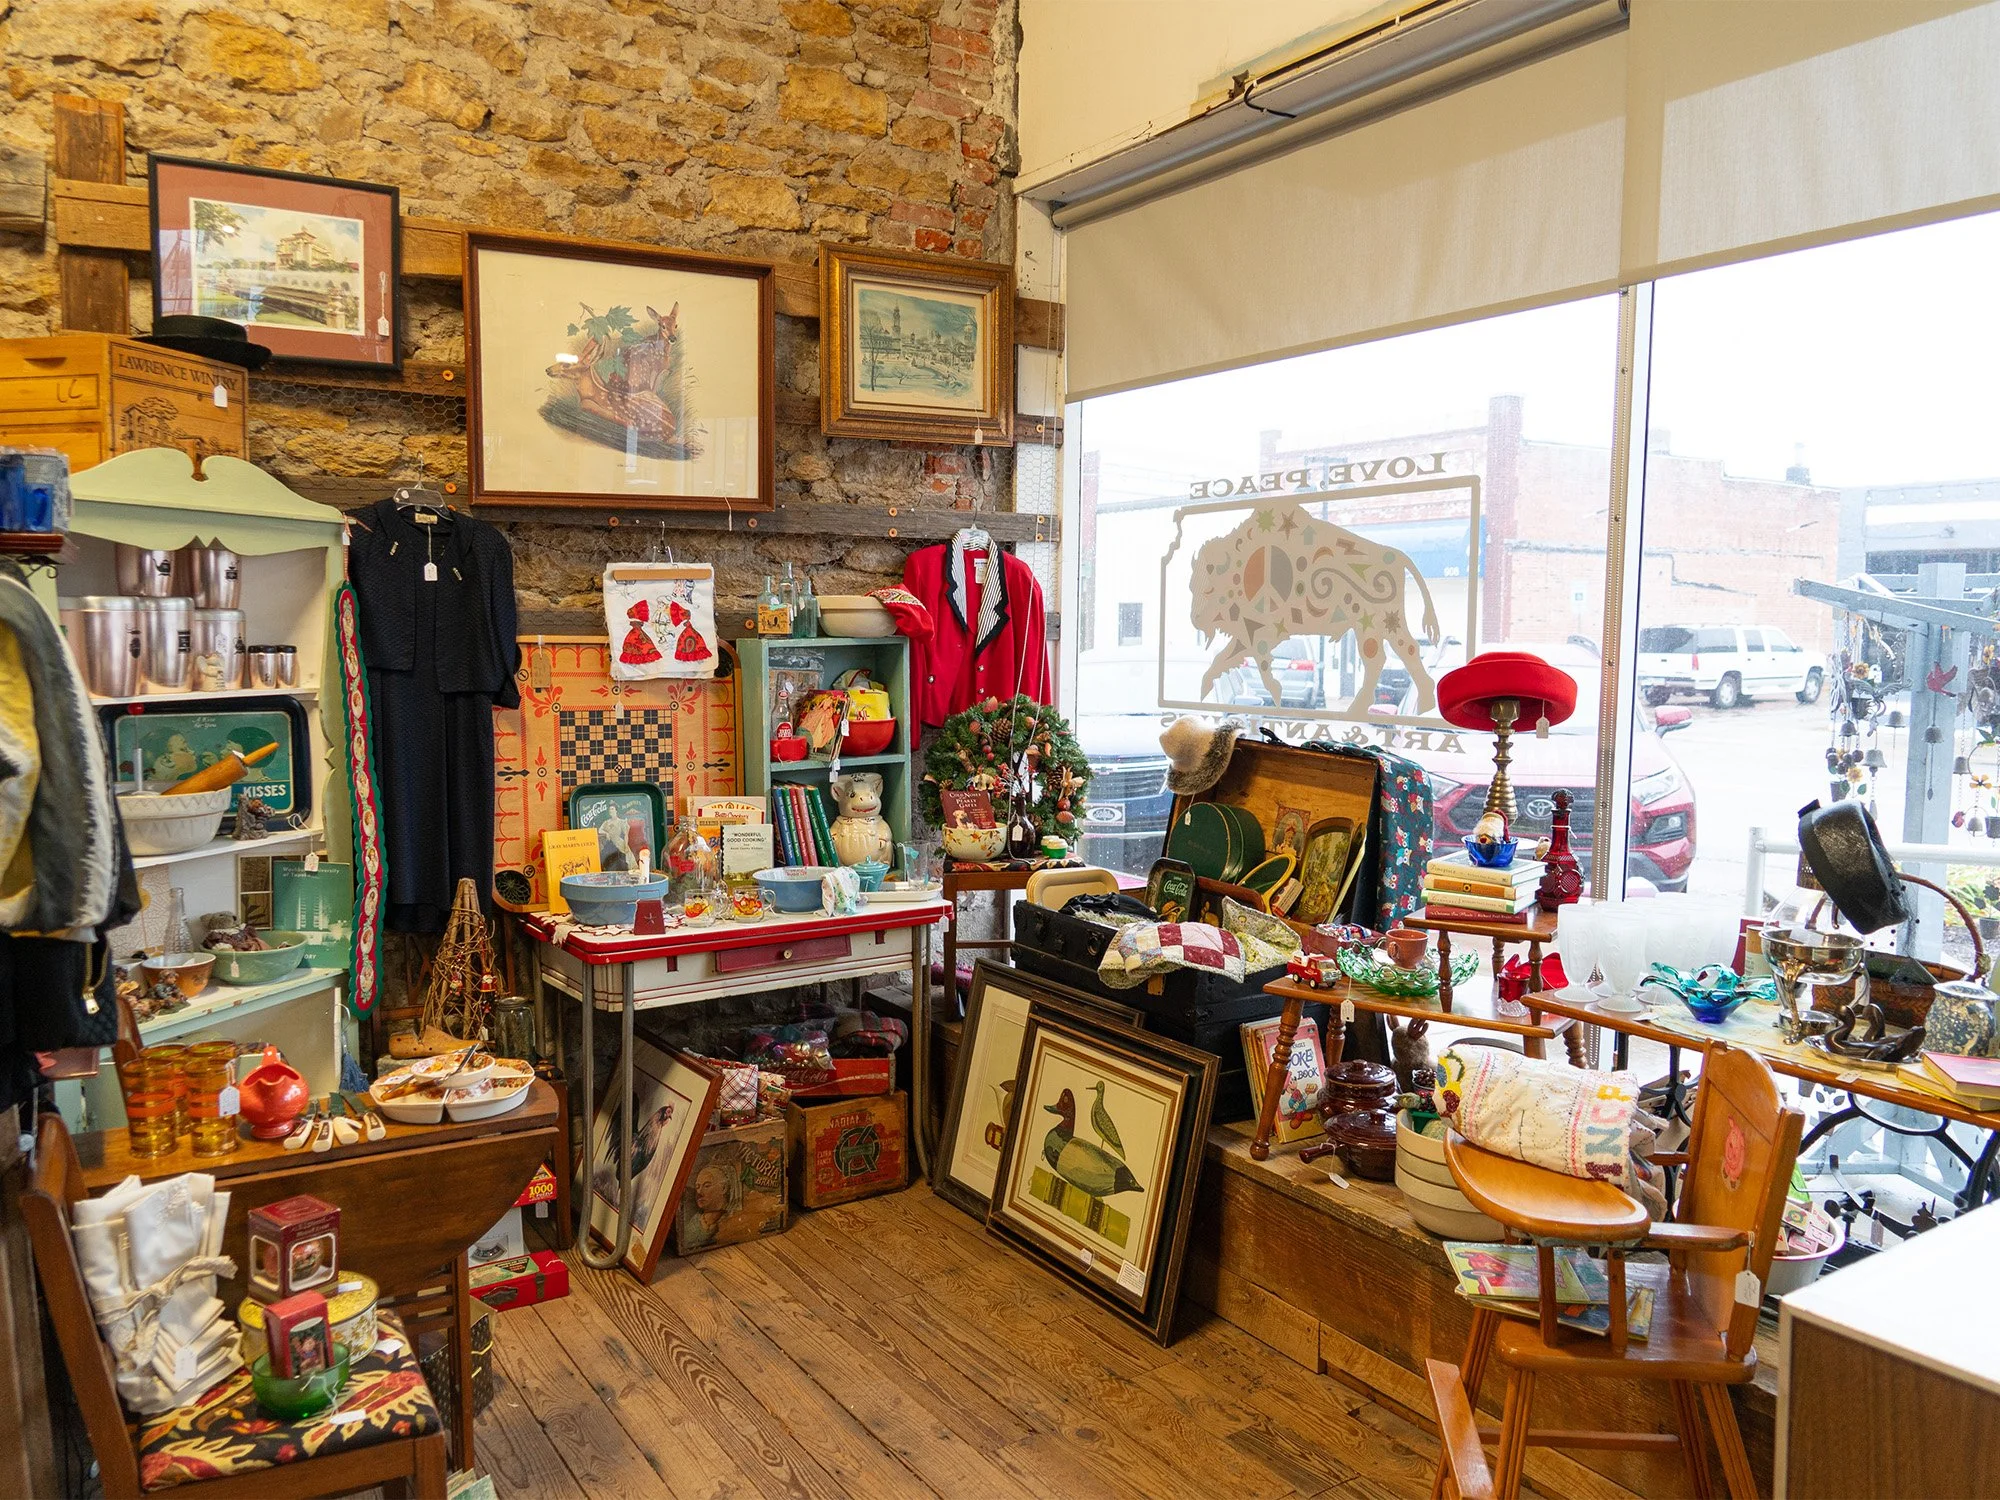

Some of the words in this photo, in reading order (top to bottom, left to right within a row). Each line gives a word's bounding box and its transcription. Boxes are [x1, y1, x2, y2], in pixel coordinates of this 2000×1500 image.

[118, 354, 187, 380] LAWRENCE
[190, 368, 238, 390] WINERY
[242, 784, 286, 798] KISSES
[1164, 880, 1188, 896] Coca-Cola
[1297, 1068, 1319, 1080] BOOK
[740, 1143, 779, 1179] VICTORIA
[529, 1183, 554, 1195] 1000
[756, 1177, 779, 1187] BRAND
